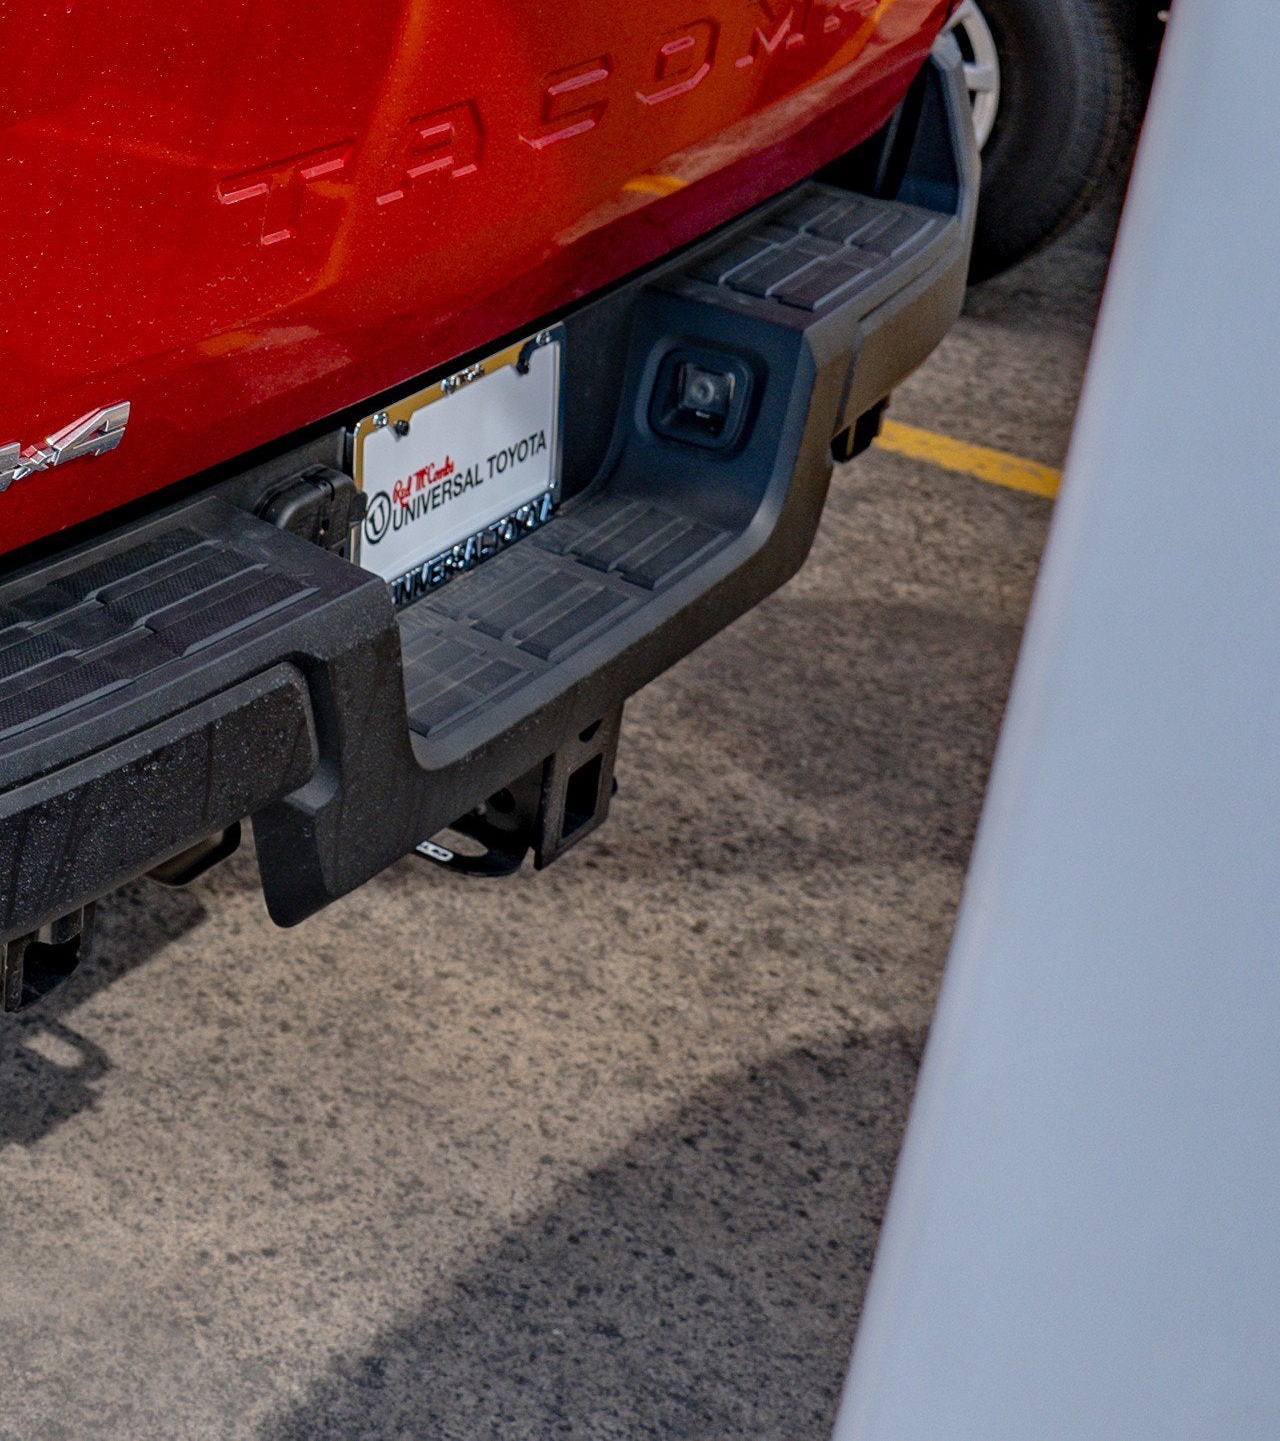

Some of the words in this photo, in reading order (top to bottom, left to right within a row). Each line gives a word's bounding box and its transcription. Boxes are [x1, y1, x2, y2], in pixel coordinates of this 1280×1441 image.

[392, 462, 484, 532] UNIVERSAL
[486, 428, 547, 479] TOYOTA
[392, 475, 412, 509] Red
